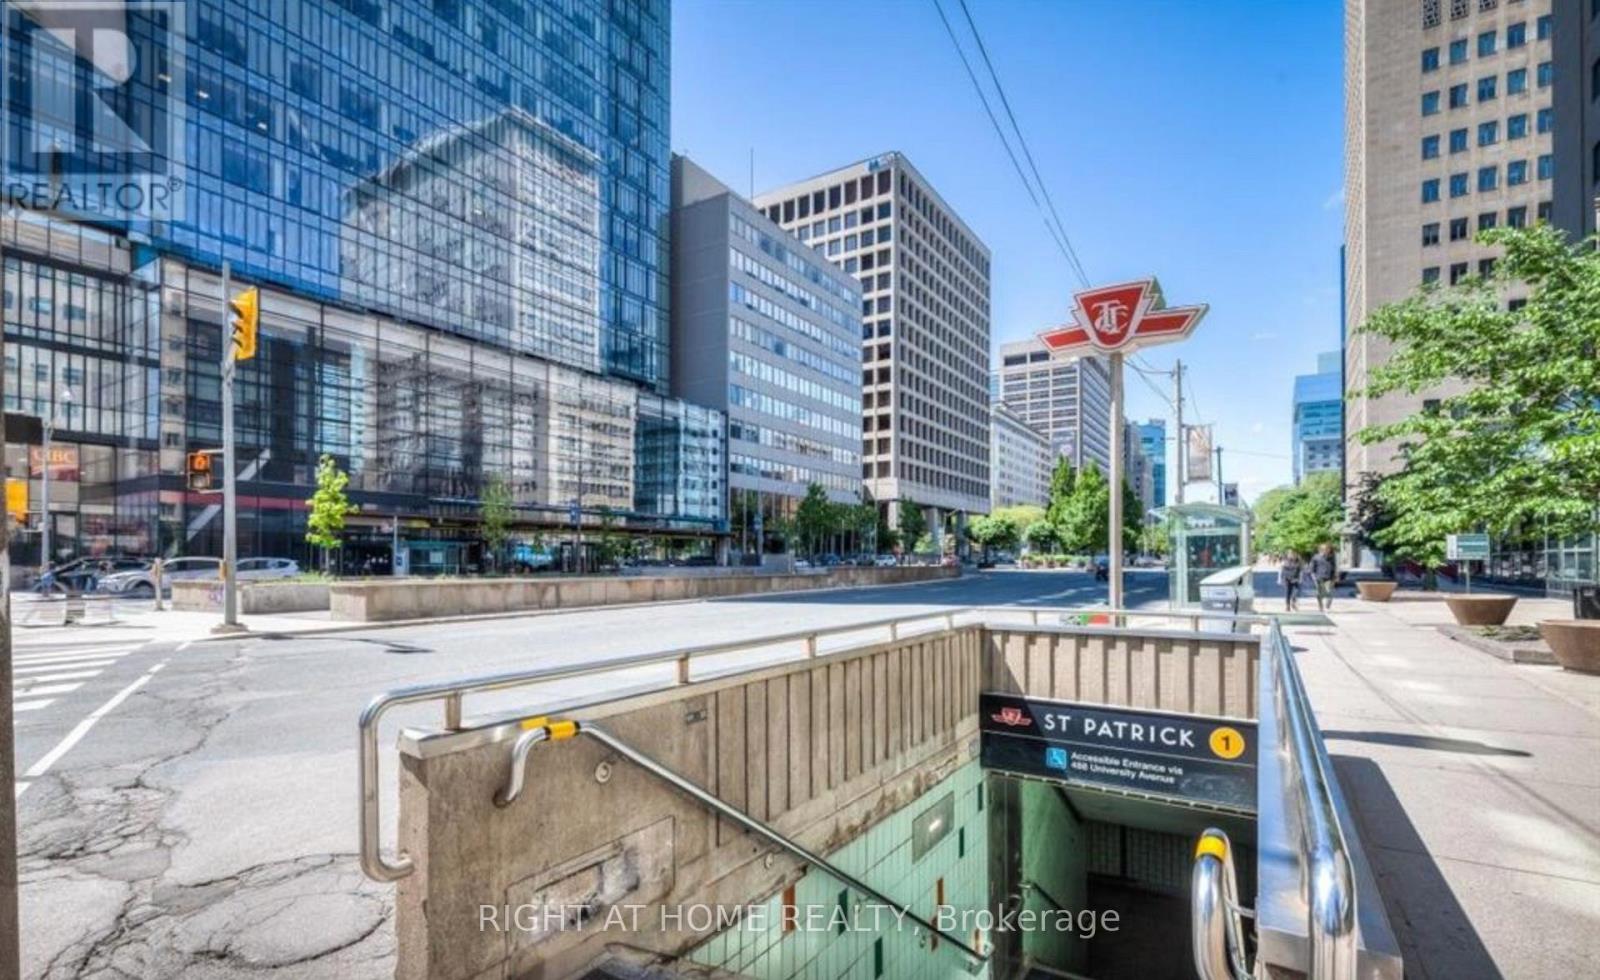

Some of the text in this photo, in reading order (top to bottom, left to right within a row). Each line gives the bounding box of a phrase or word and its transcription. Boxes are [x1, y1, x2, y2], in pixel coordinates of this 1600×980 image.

[1043, 714, 1071, 733] ST
[1084, 718, 1195, 748] PATRICK
[1221, 735, 1230, 751] 1
[1071, 752, 1183, 776] Accessible Entrance via
[1090, 764, 1136, 780] University
[1138, 771, 1175, 784] Avenue
